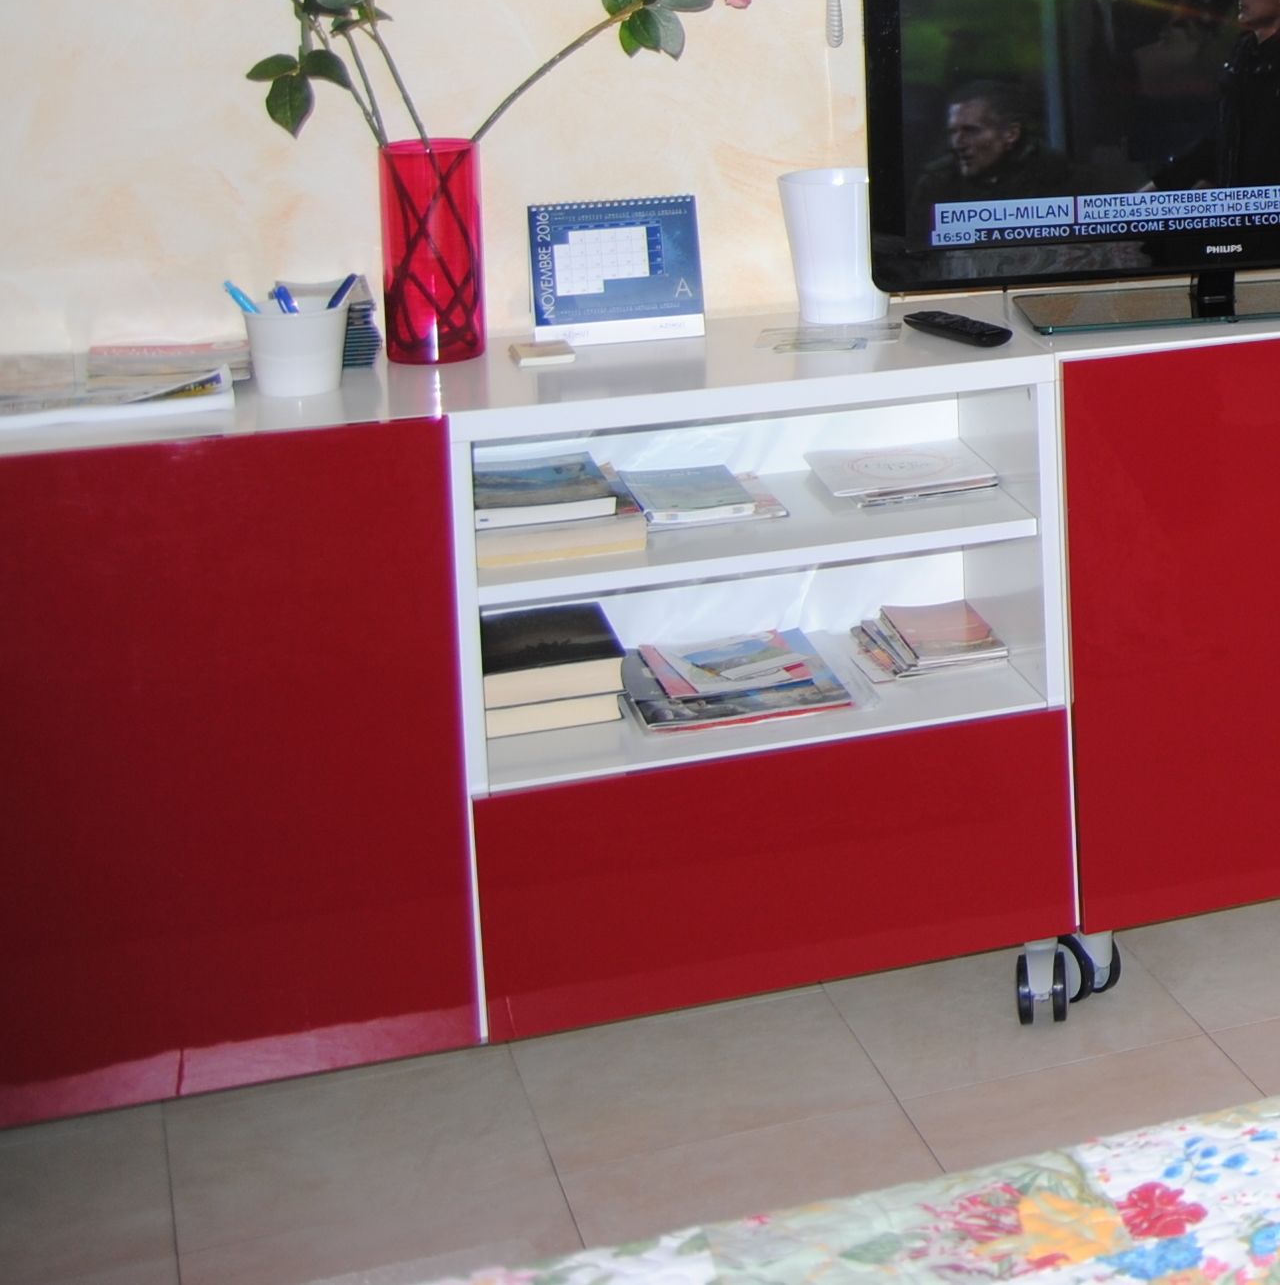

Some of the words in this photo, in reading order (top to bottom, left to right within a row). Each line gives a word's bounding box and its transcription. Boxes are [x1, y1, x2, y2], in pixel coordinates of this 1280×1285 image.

[1083, 195, 1147, 209] MONTELLA
[1150, 192, 1207, 205] POTREBBE
[1210, 188, 1270, 202] SCHIERARE
[940, 203, 1069, 225] EMPOLI-MILAN
[1083, 209, 1111, 221] ALLE
[1112, 207, 1142, 219] 20.45
[1145, 207, 1159, 217] SU
[1161, 205, 1182, 215] SKY
[1184, 203, 1218, 215] SPORT
[1220, 203, 1225, 213] 1
[1227, 202, 1242, 213] HD
[1245, 201, 1250, 211] E
[536, 213, 551, 242] 2016
[935, 231, 971, 243] 16:50
[992, 229, 1001, 241] A
[1004, 225, 1070, 240] GOVERNO
[1073, 222, 1127, 236] TECNICO
[1130, 219, 1165, 233] COME
[1168, 216, 1242, 230] SUGGERISCE
[1206, 244, 1243, 255] PHILIPS
[540, 246, 555, 319] NOVEMBRE
